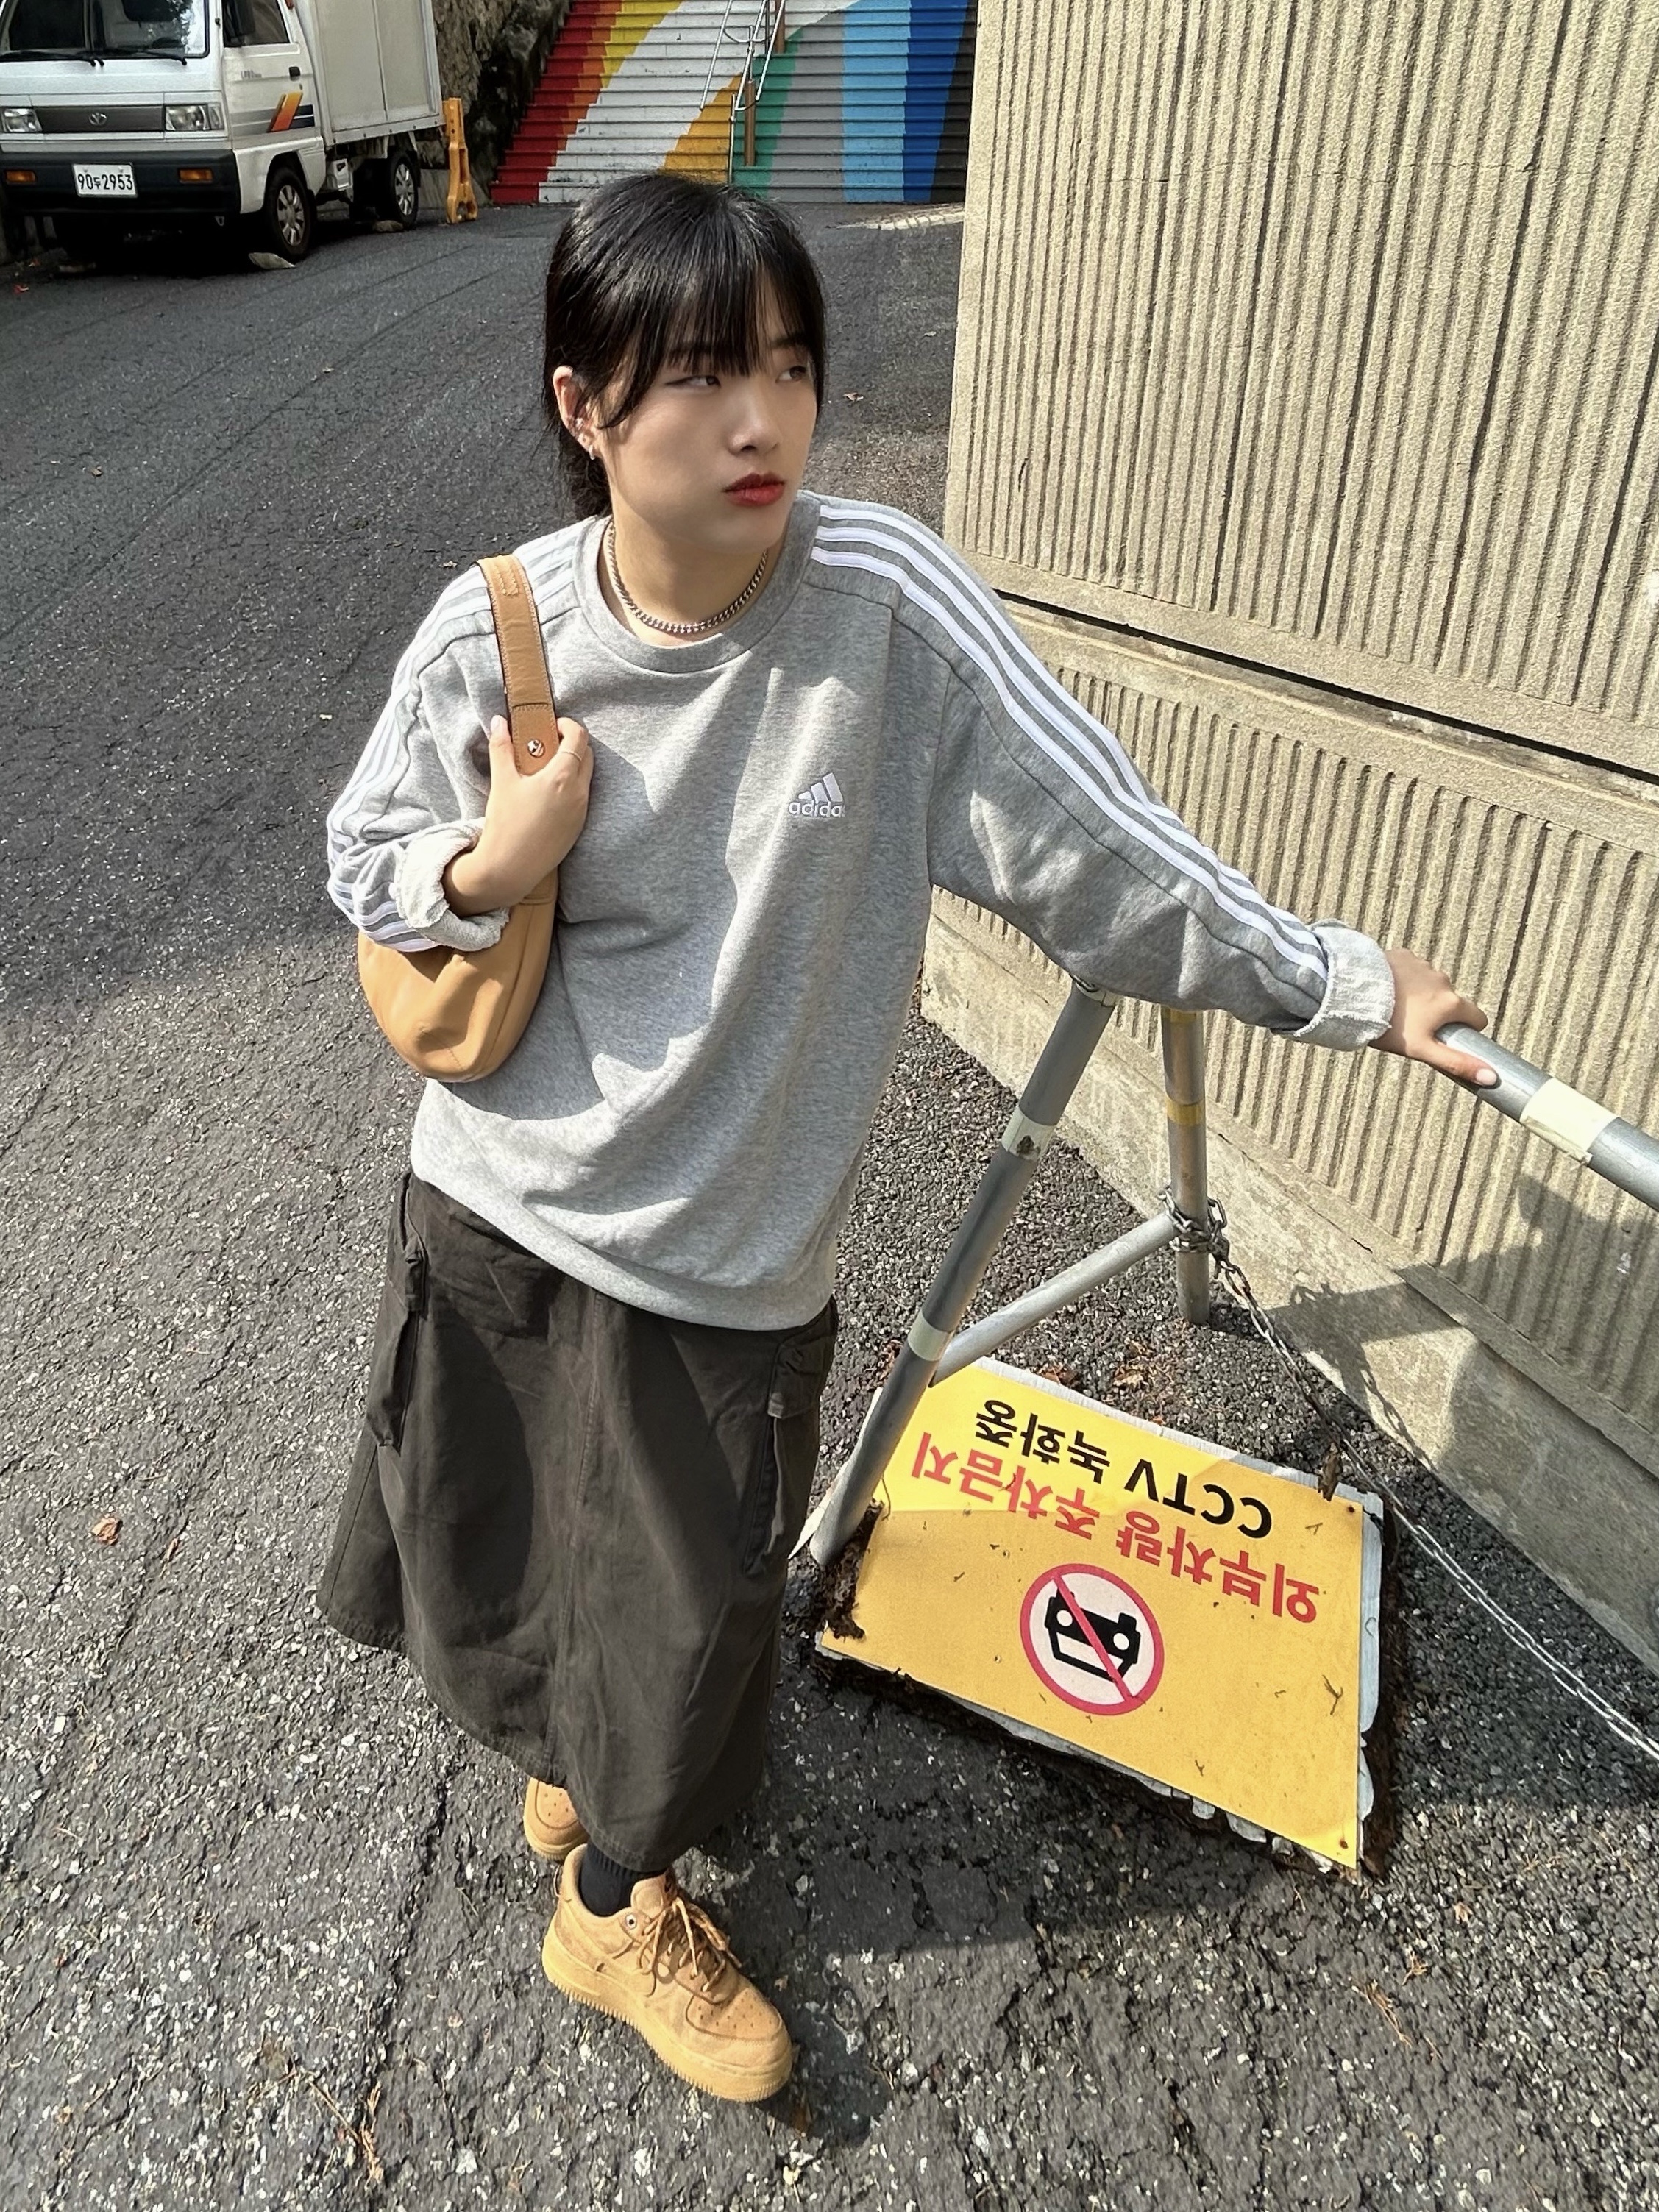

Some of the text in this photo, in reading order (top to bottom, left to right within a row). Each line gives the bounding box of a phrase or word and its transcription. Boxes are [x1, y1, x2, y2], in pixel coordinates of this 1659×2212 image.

[77, 174, 133, 190] 90두2953
[911, 1432, 1320, 1623] 외부차량 주차금지
[975, 1399, 1273, 1539] CCTV 녹화중
